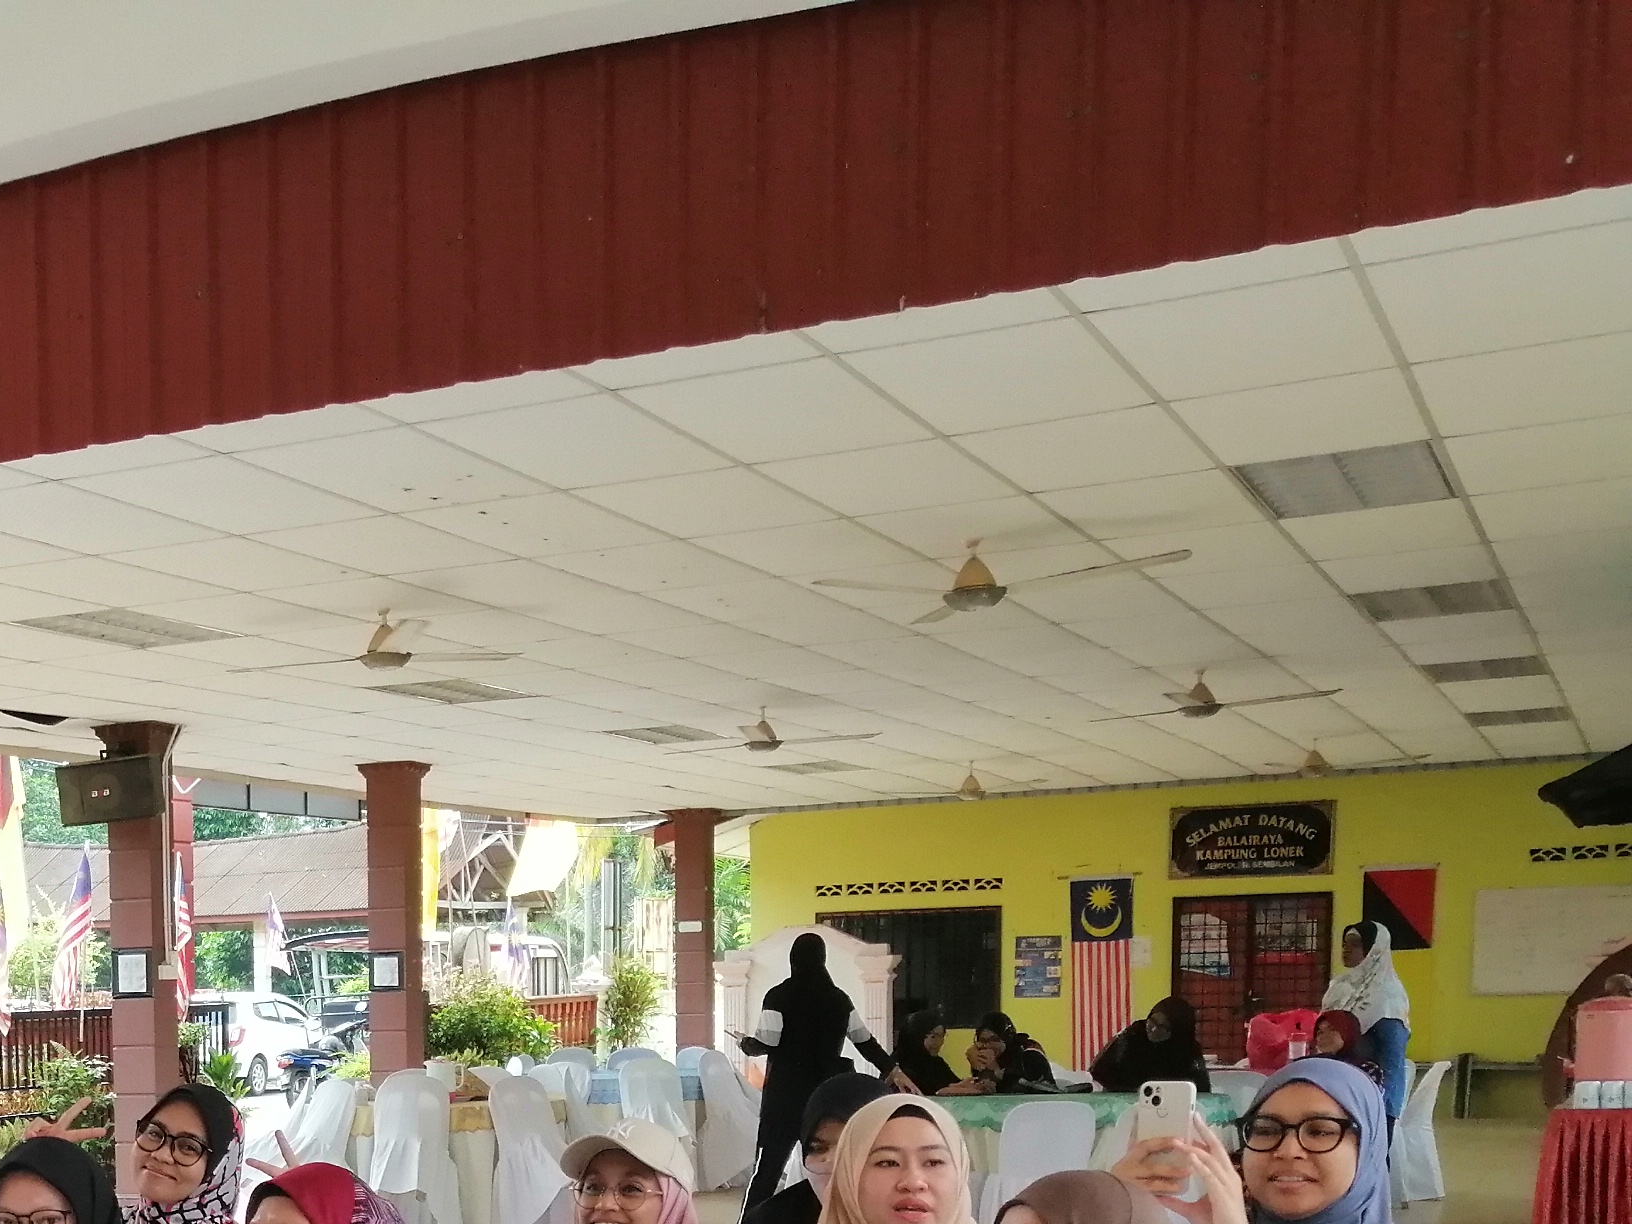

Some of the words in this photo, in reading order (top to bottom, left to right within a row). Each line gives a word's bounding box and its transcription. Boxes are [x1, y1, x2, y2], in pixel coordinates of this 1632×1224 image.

[1185, 814, 1250, 847] SELAMAT
[1257, 814, 1318, 841] DATANG
[1217, 833, 1284, 847] BALAIRAYA
[1195, 848, 1257, 861] KAMPUNG
[1264, 846, 1305, 858] LONEK
